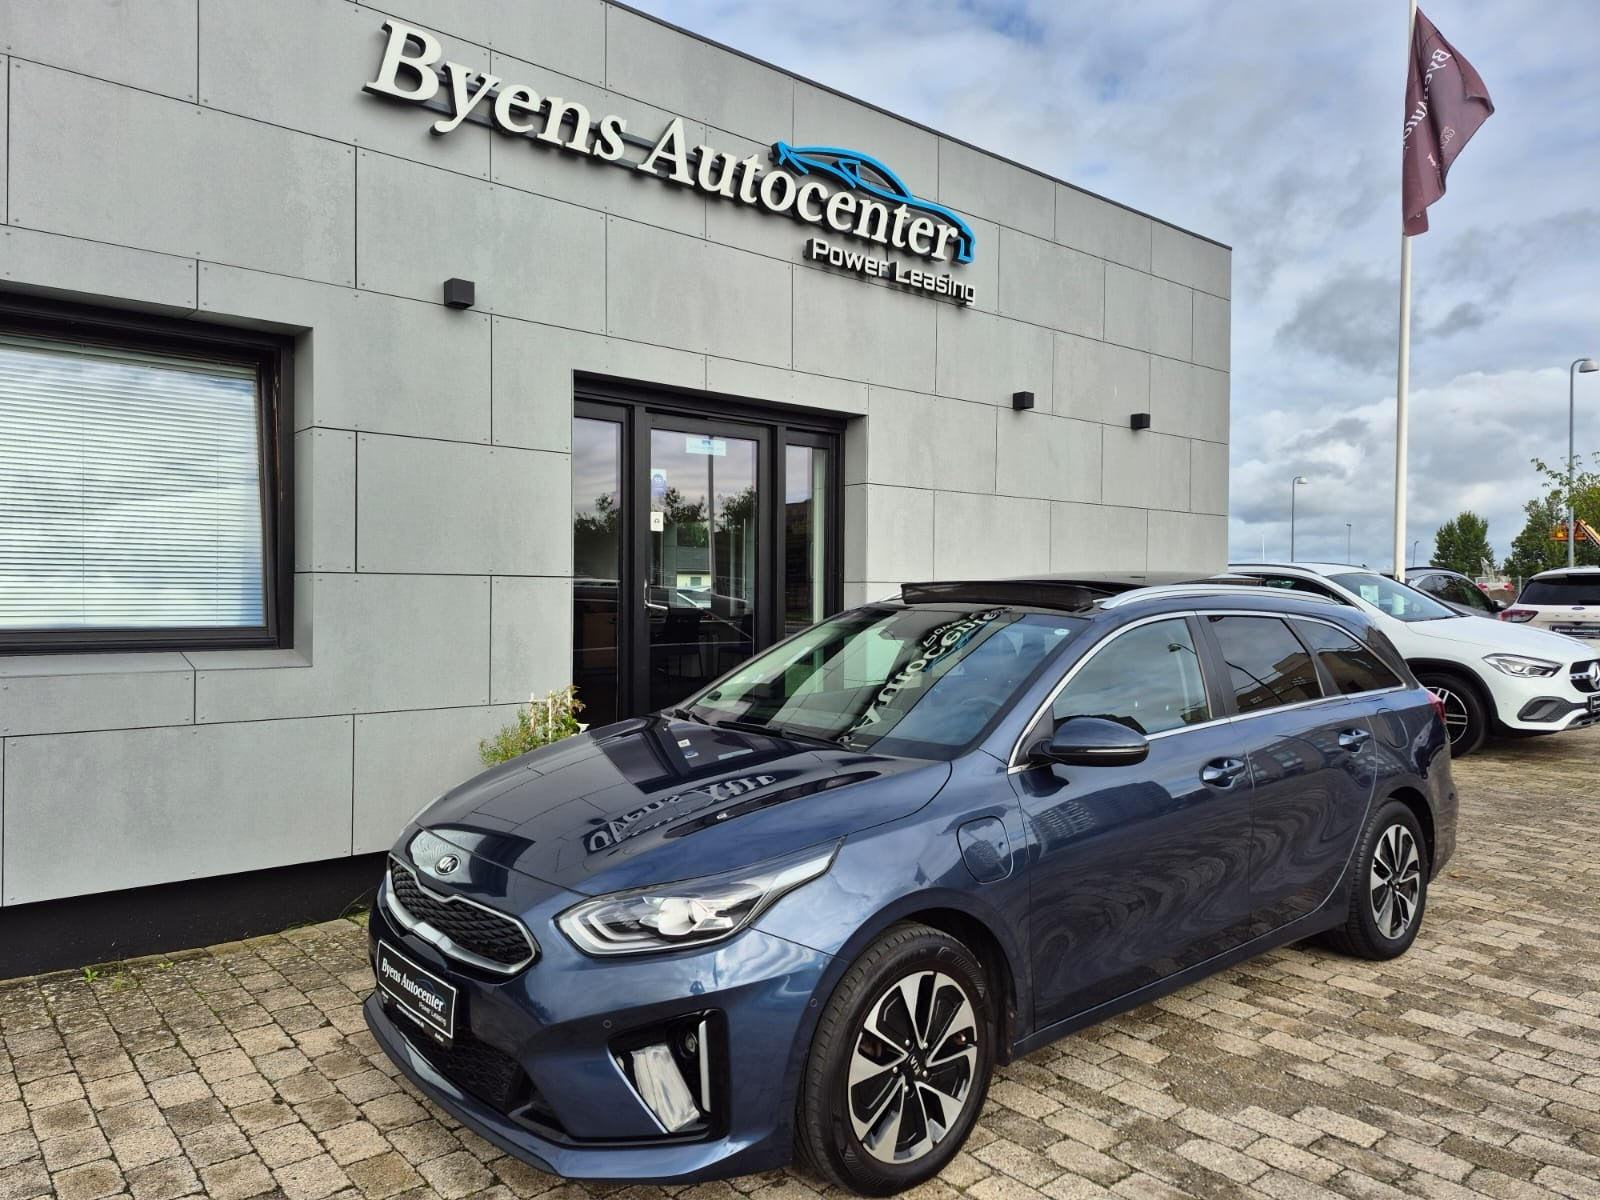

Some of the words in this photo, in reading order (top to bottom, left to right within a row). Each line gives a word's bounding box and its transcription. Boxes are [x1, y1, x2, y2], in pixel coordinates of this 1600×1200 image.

[363, 19, 628, 162] Byens
[638, 117, 958, 262] Autocenter
[807, 237, 889, 277] Power
[894, 260, 977, 307] Leasing
[382, 957, 402, 983] Byens
[402, 973, 445, 1011] Autocenter
